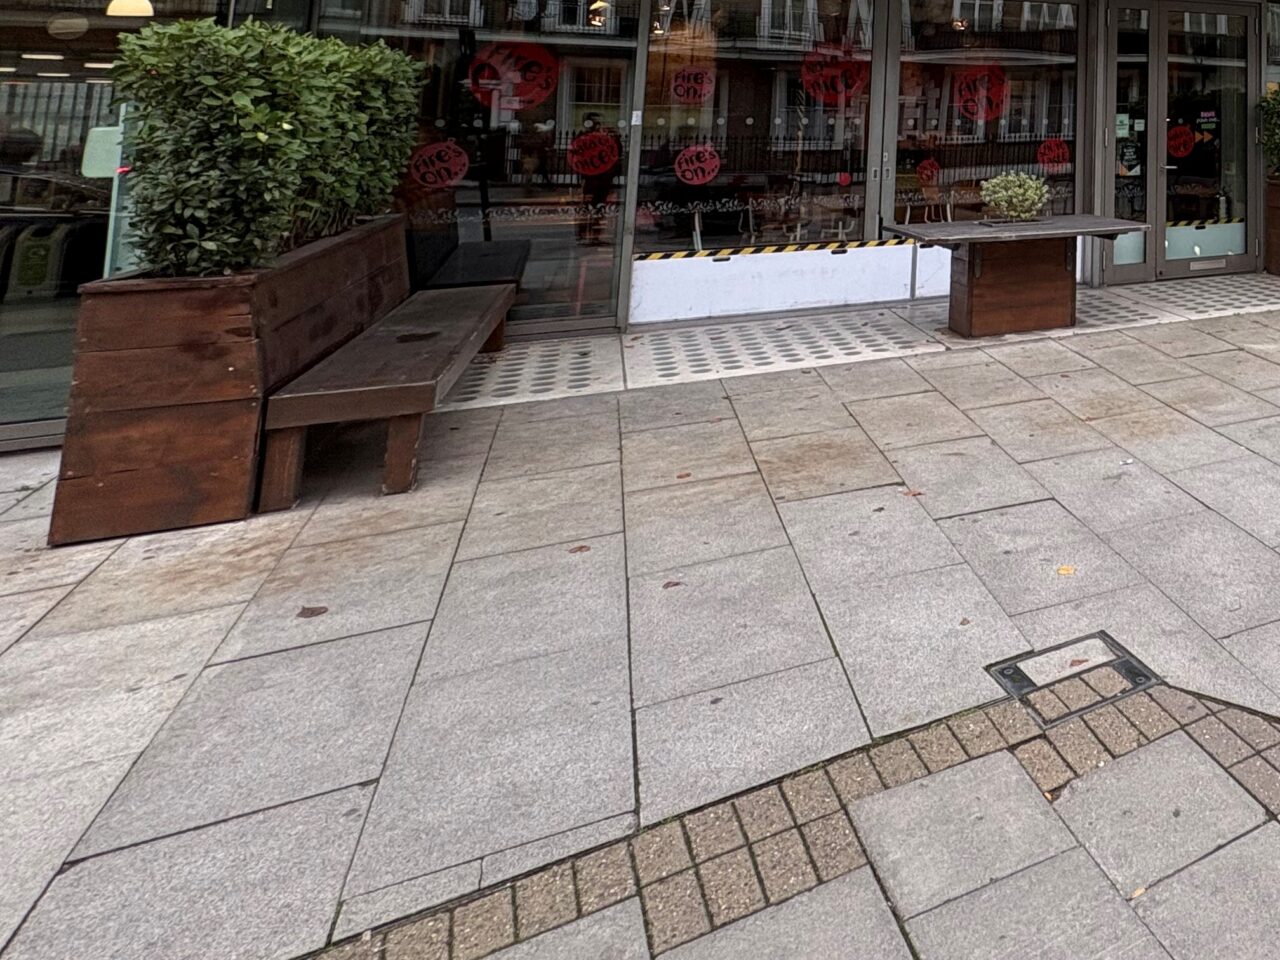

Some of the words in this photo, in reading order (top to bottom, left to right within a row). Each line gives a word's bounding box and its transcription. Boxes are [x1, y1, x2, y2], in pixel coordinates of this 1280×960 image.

[674, 71, 713, 84] Fire's
[413, 144, 463, 173] Fire's
[678, 147, 716, 170] Fire's
